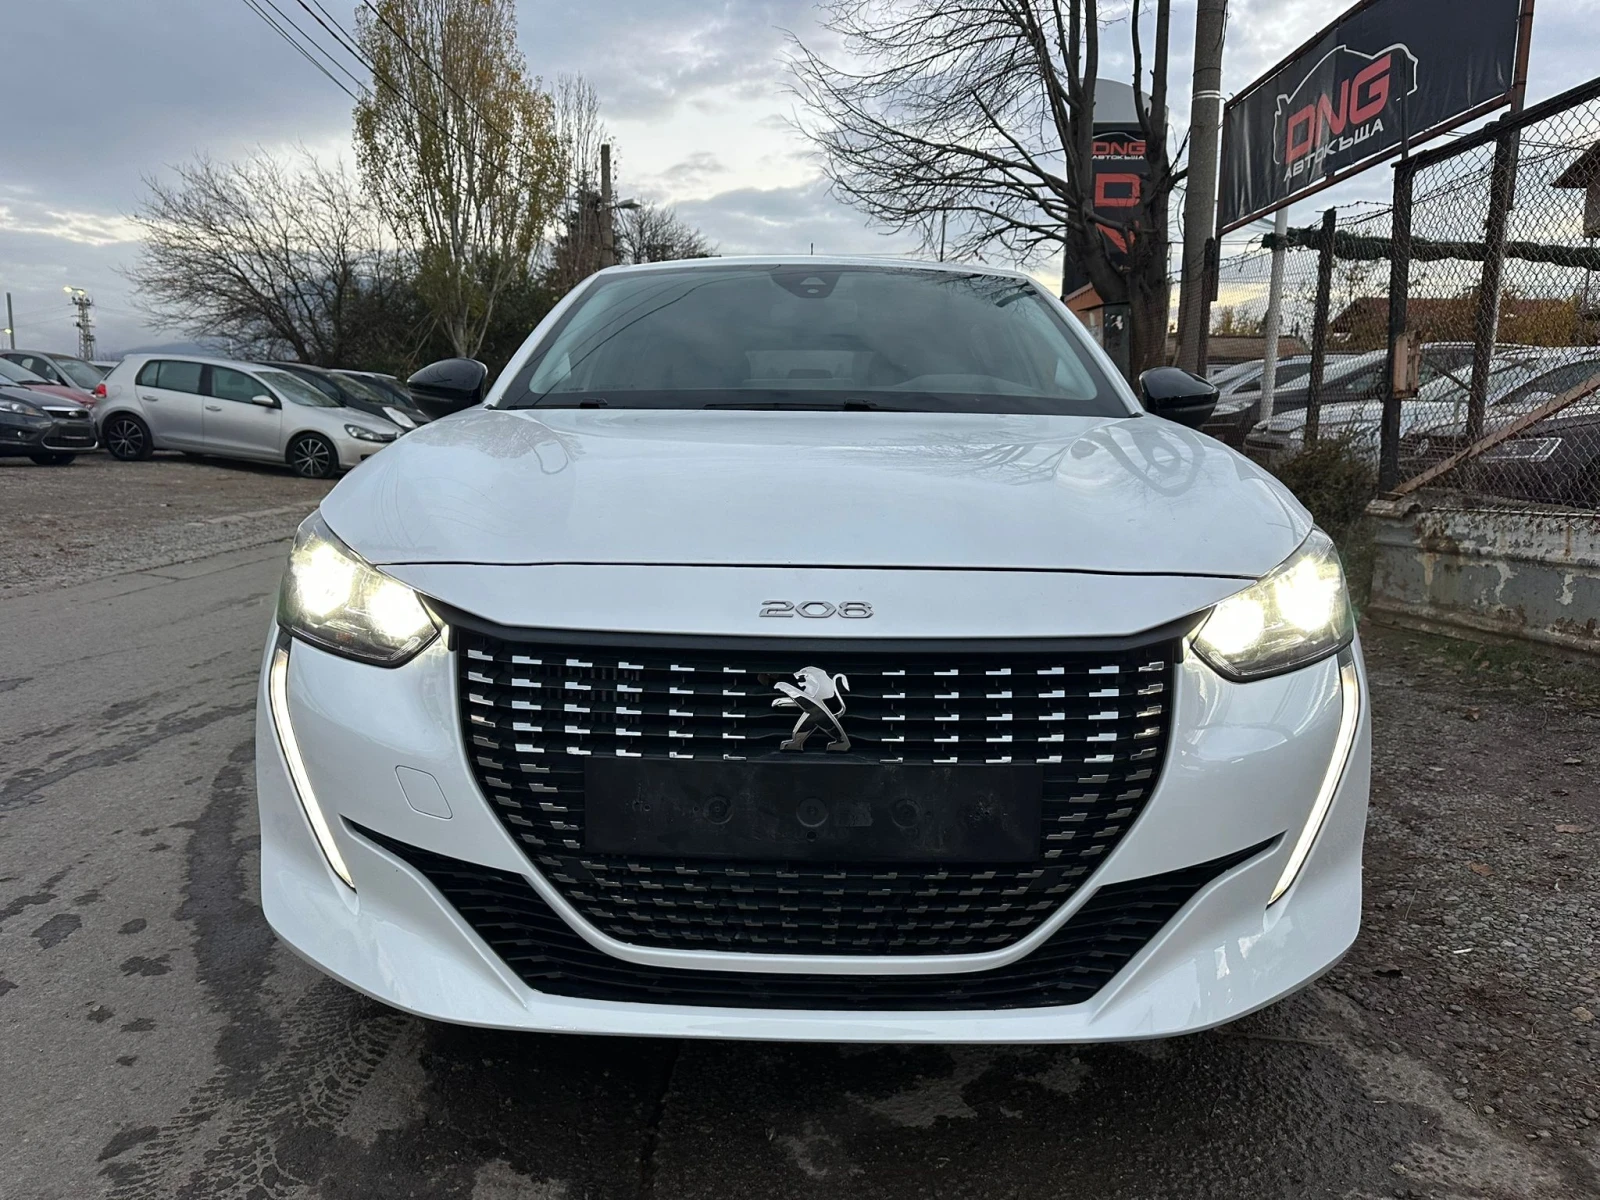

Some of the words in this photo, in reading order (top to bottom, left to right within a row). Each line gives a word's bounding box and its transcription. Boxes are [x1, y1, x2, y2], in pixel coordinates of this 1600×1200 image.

[1285, 53, 1392, 165] DNG
[1092, 141, 1146, 155] DNG
[759, 600, 874, 619] 208
